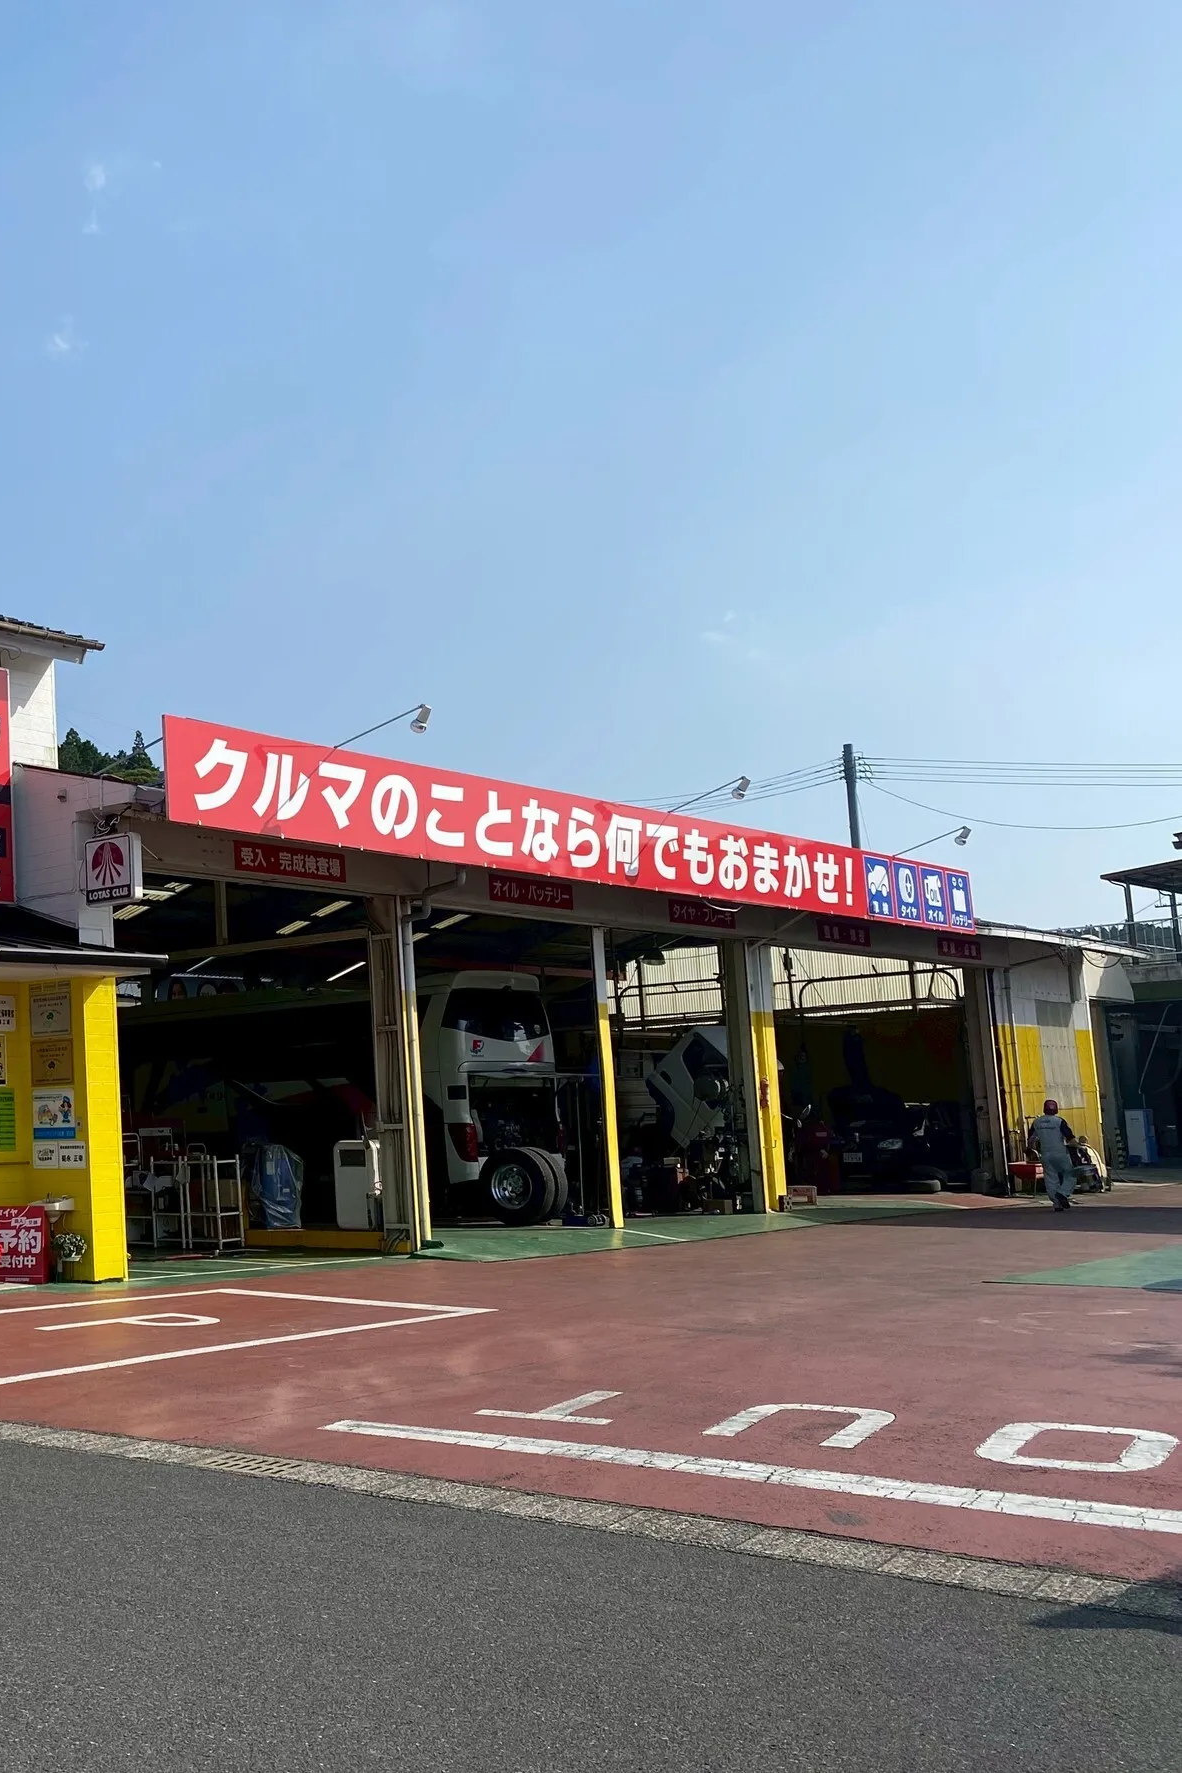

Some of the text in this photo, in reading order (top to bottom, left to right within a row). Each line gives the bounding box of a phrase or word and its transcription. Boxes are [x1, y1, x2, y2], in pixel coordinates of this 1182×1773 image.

[194, 738, 854, 906] クルマのことなら何でもおまかせ!
[240, 847, 341, 878] 受入・完成検査場
[89, 889, 111, 900] LOTAS
[492, 880, 570, 903] オイル・バッテリー
[929, 891, 940, 904] OIL
[900, 906, 918, 919] タイヤ
[927, 909, 945, 923] オイル
[951, 913, 972, 927] バッテリー
[0, 1255, 36, 1268] 受付中
